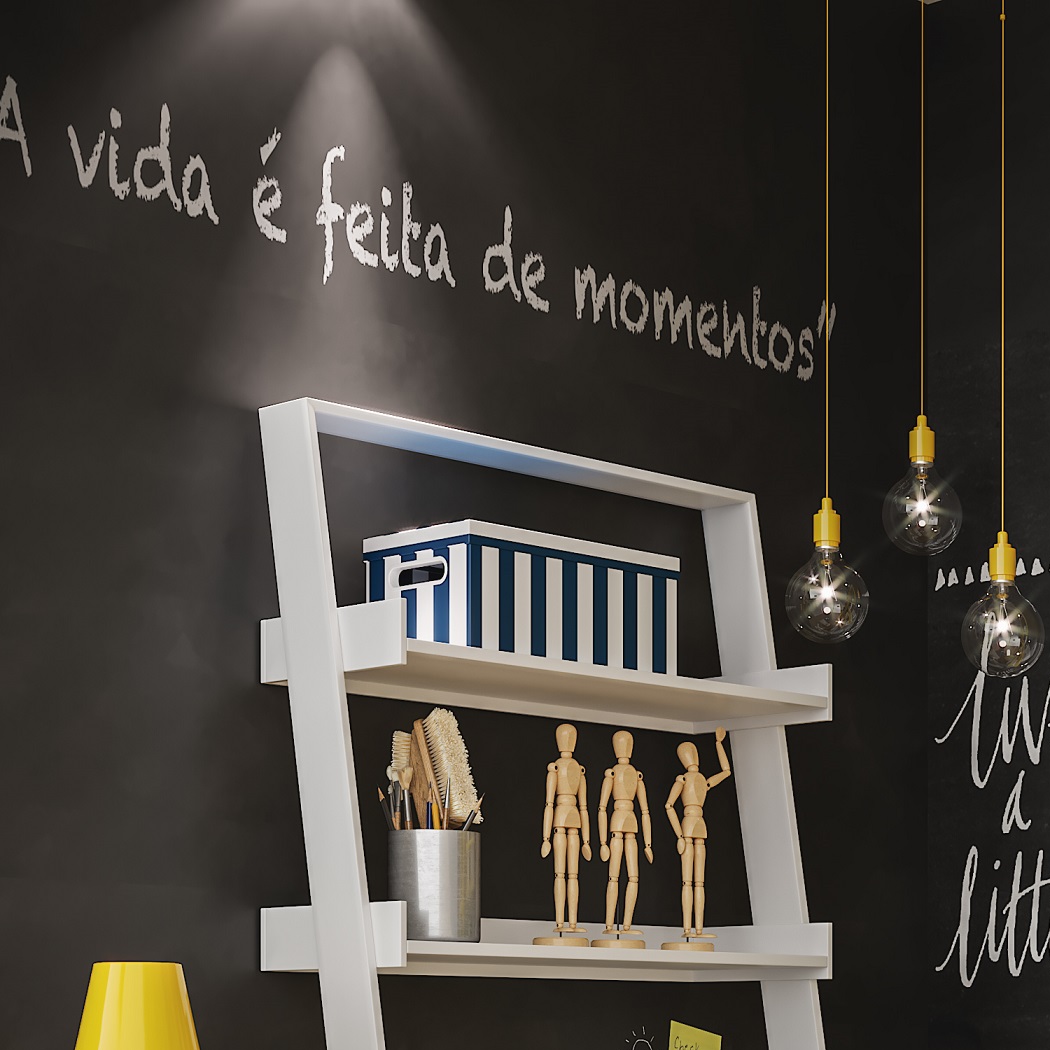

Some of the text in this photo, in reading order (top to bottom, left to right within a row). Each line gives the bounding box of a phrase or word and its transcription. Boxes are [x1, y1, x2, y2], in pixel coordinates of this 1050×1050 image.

[0, 75, 32, 178] A
[68, 103, 219, 225] vida
[253, 128, 286, 243] é
[316, 144, 456, 288] feita
[483, 206, 550, 313] de
[1002, 770, 1031, 833] a
